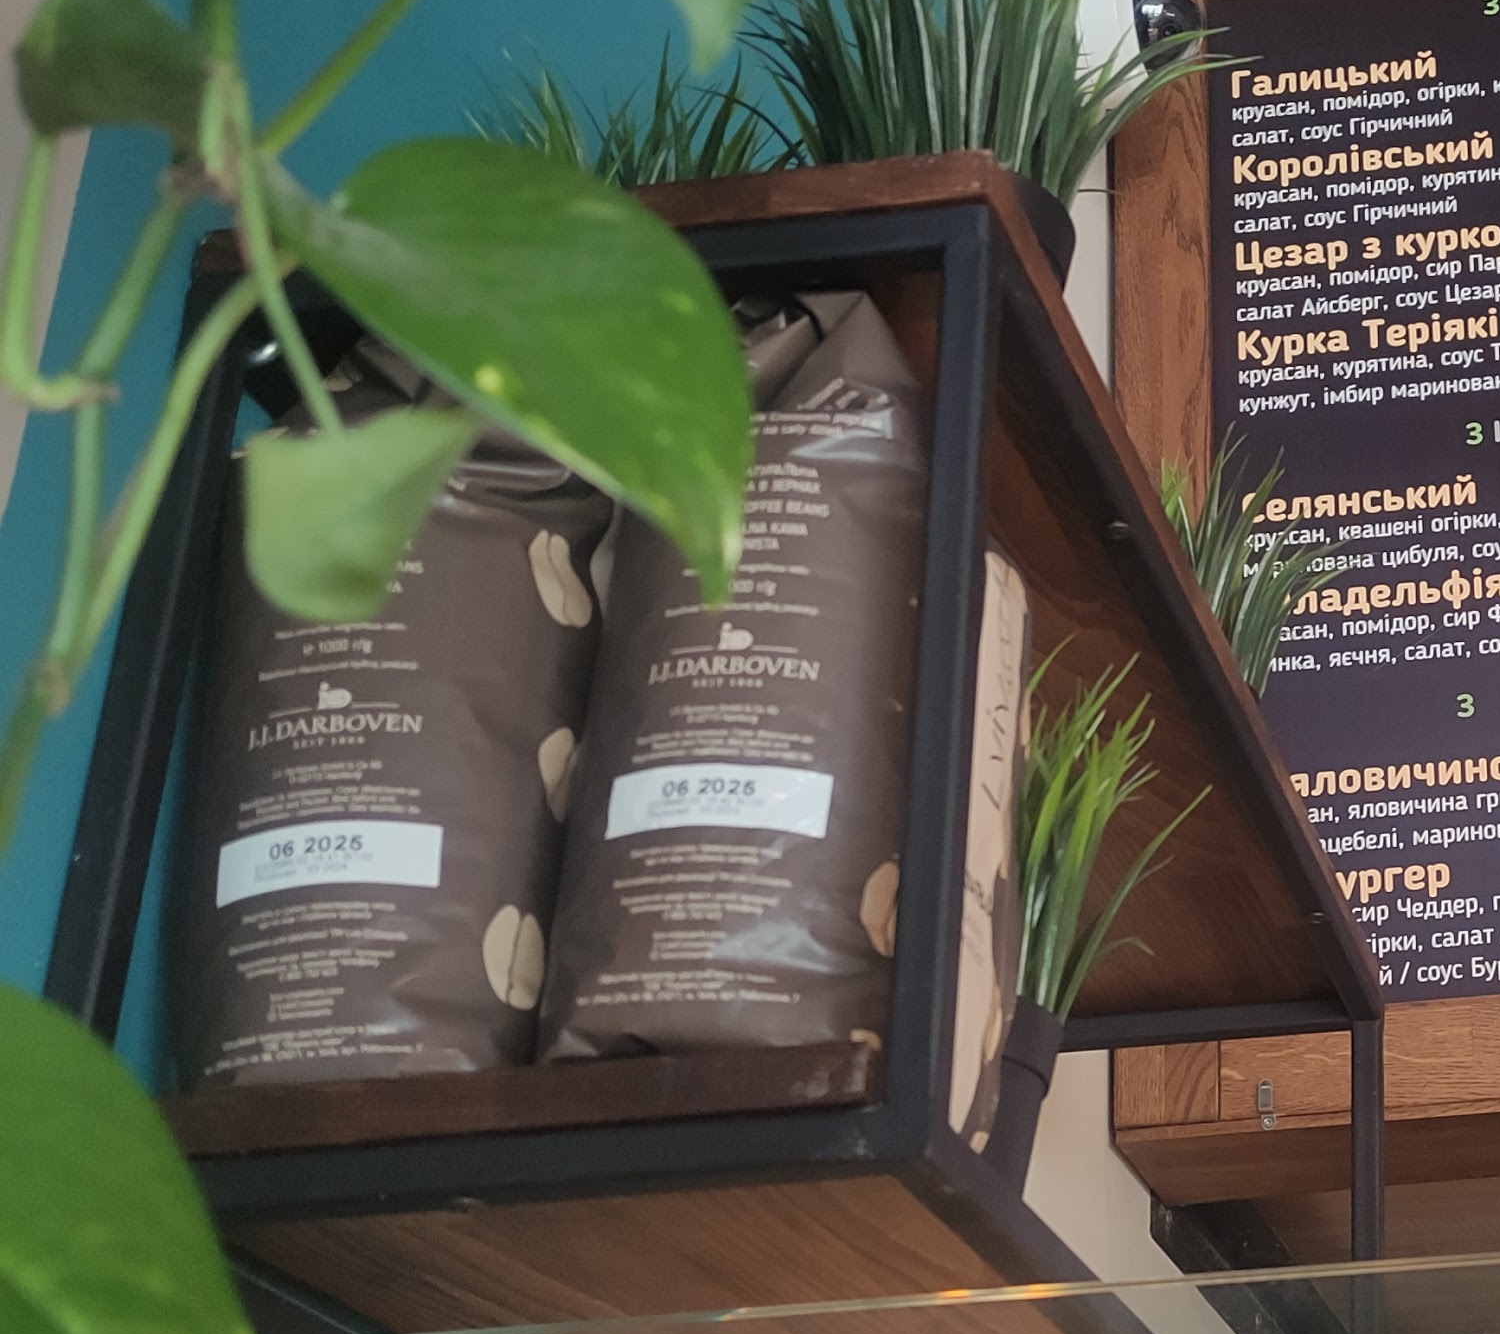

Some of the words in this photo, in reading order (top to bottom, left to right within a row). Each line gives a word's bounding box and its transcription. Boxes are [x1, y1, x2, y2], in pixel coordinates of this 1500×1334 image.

[1230, 49, 1438, 100] Галицький
[1231, 99, 1317, 126] круасан,
[1322, 89, 1412, 113] помідор,
[1416, 80, 1487, 104] огірки,
[1232, 129, 1494, 188] Королівський
[1234, 239, 1349, 276] Цезар
[1235, 273, 1323, 299] круасан,
[1328, 263, 1420, 287] помідор,
[1424, 259, 1463, 280] сир
[1237, 328, 1351, 367] Курка
[1360, 306, 1499, 354] Теріякі
[1237, 363, 1326, 389] круасан,
[1331, 353, 1435, 381] курятина,
[1439, 347, 1485, 370] соус
[1241, 473, 1478, 525] Селянський
[661, 779, 690, 798] 06
[1346, 794, 1470, 821] яловичина
[268, 840, 295, 861] 06
[1334, 862, 1451, 905] ургер
[1395, 896, 1485, 922] Чеддер,
